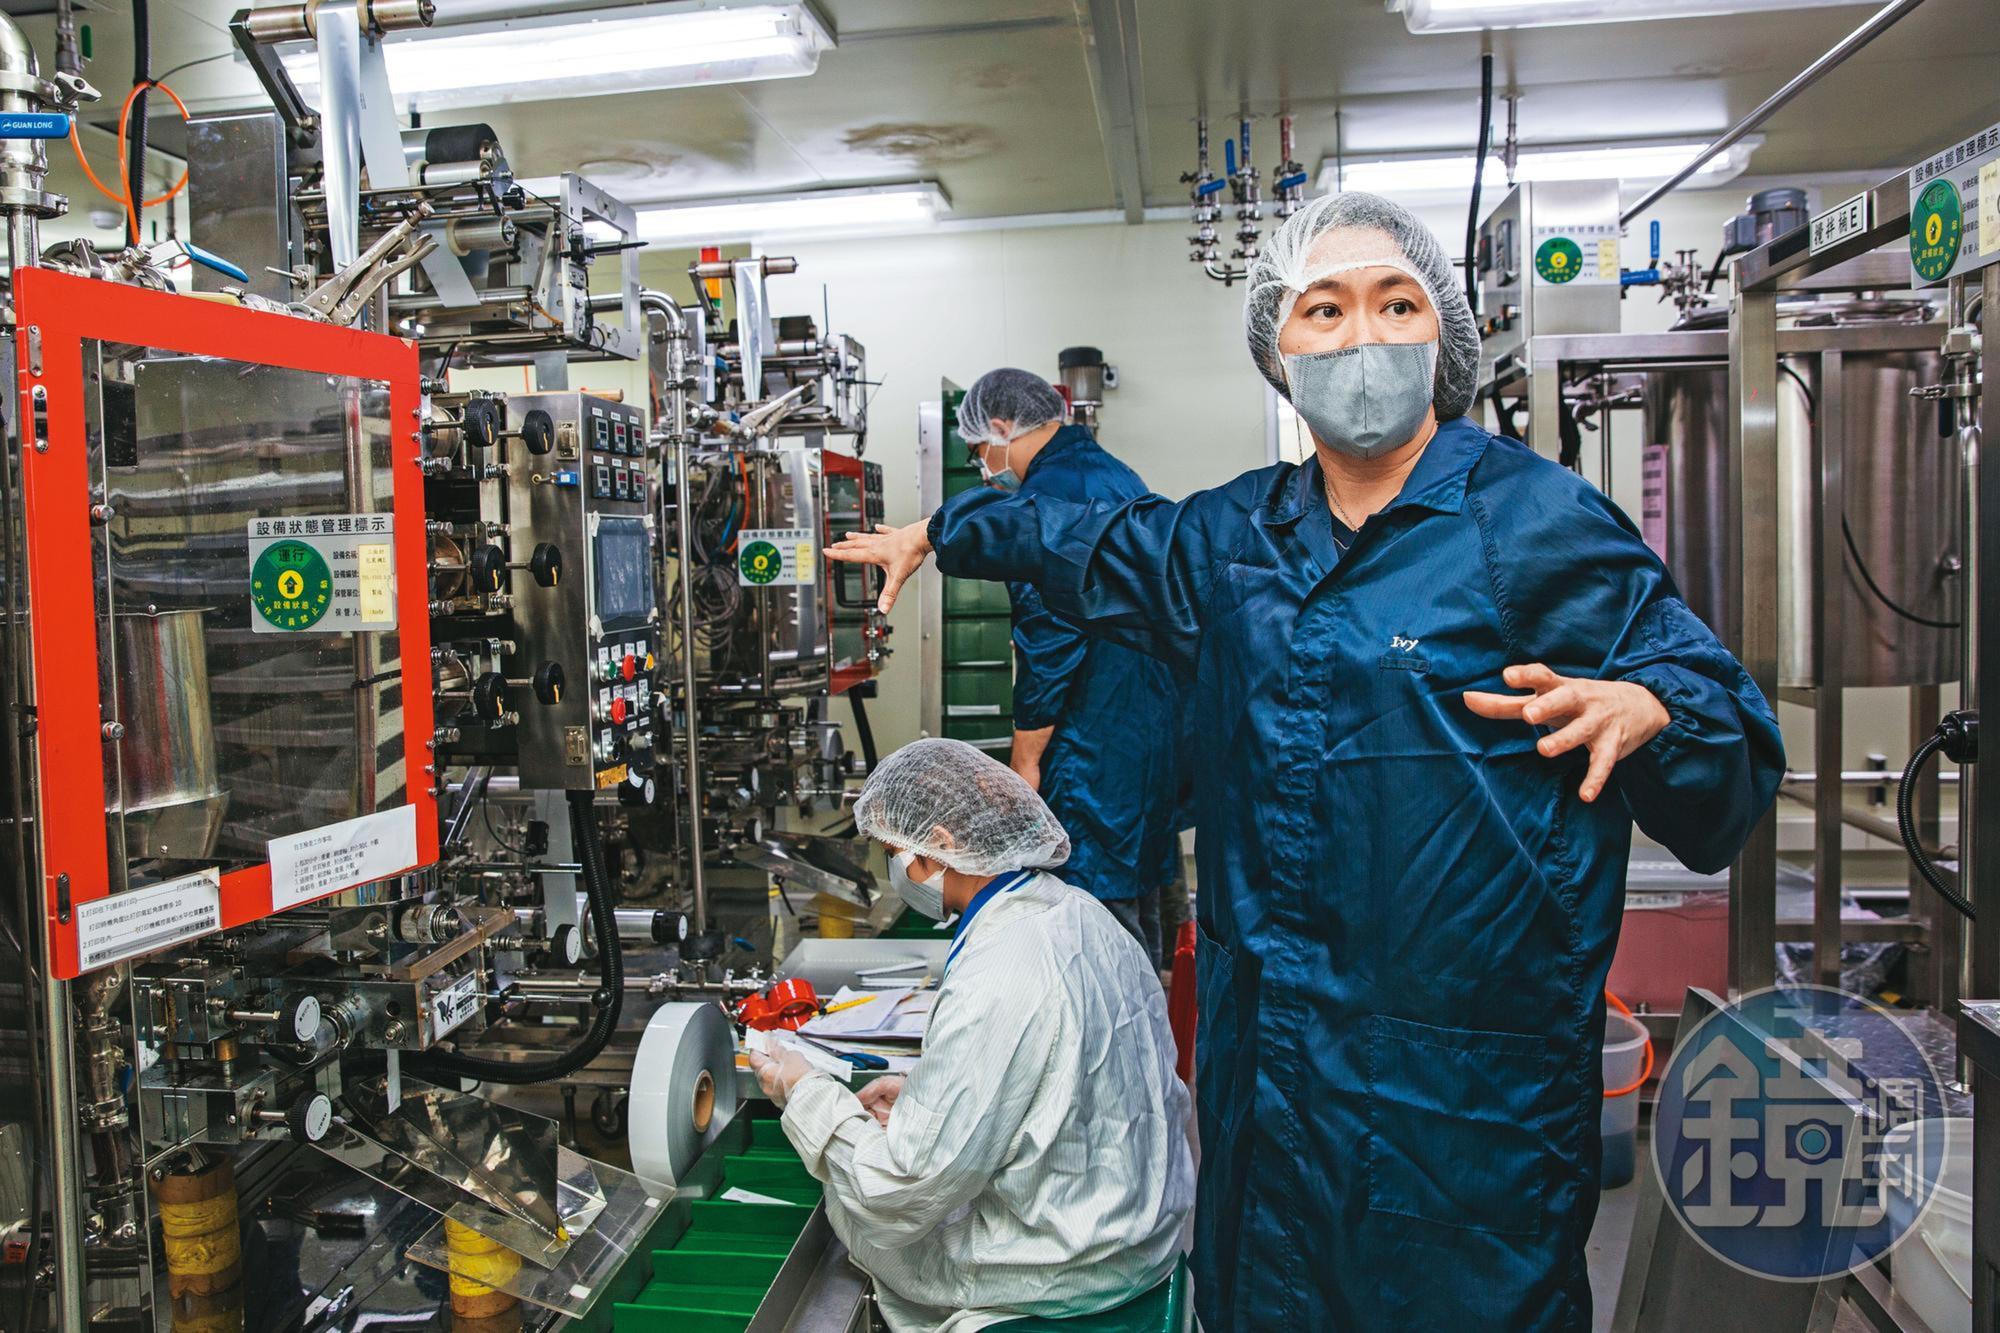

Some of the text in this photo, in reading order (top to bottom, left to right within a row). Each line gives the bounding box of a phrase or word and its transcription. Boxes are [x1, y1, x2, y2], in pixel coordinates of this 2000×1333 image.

[12, 121, 53, 129] GUAN LONG
[1915, 128, 1999, 183] 設備狀態管理標示
[256, 517, 385, 536] 設備狀態管理標示
[279, 548, 305, 562] 運行
[273, 600, 309, 610] 設備狀態
[1390, 636, 1419, 652] Ivy
